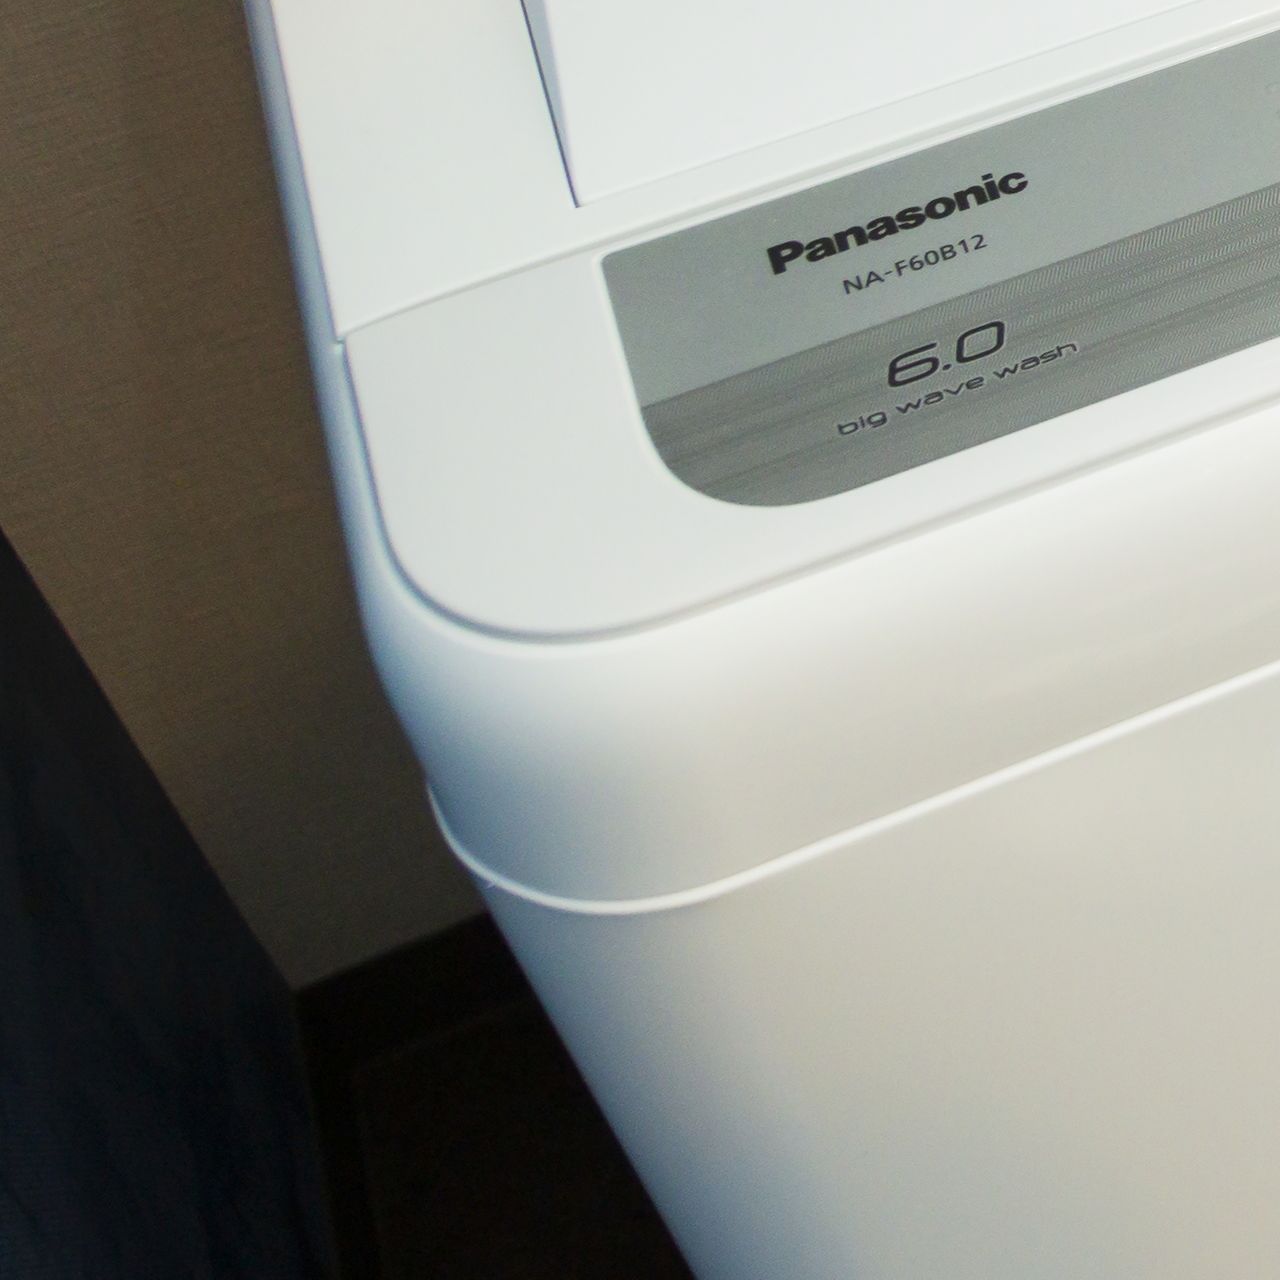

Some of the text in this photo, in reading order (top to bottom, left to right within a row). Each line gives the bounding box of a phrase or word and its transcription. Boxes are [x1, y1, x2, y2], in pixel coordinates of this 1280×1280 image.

[766, 171, 1029, 275] Panasonic
[842, 234, 988, 295] NA-F60B12
[836, 342, 1078, 436] big wave wash
[887, 320, 1006, 388] 6.0
